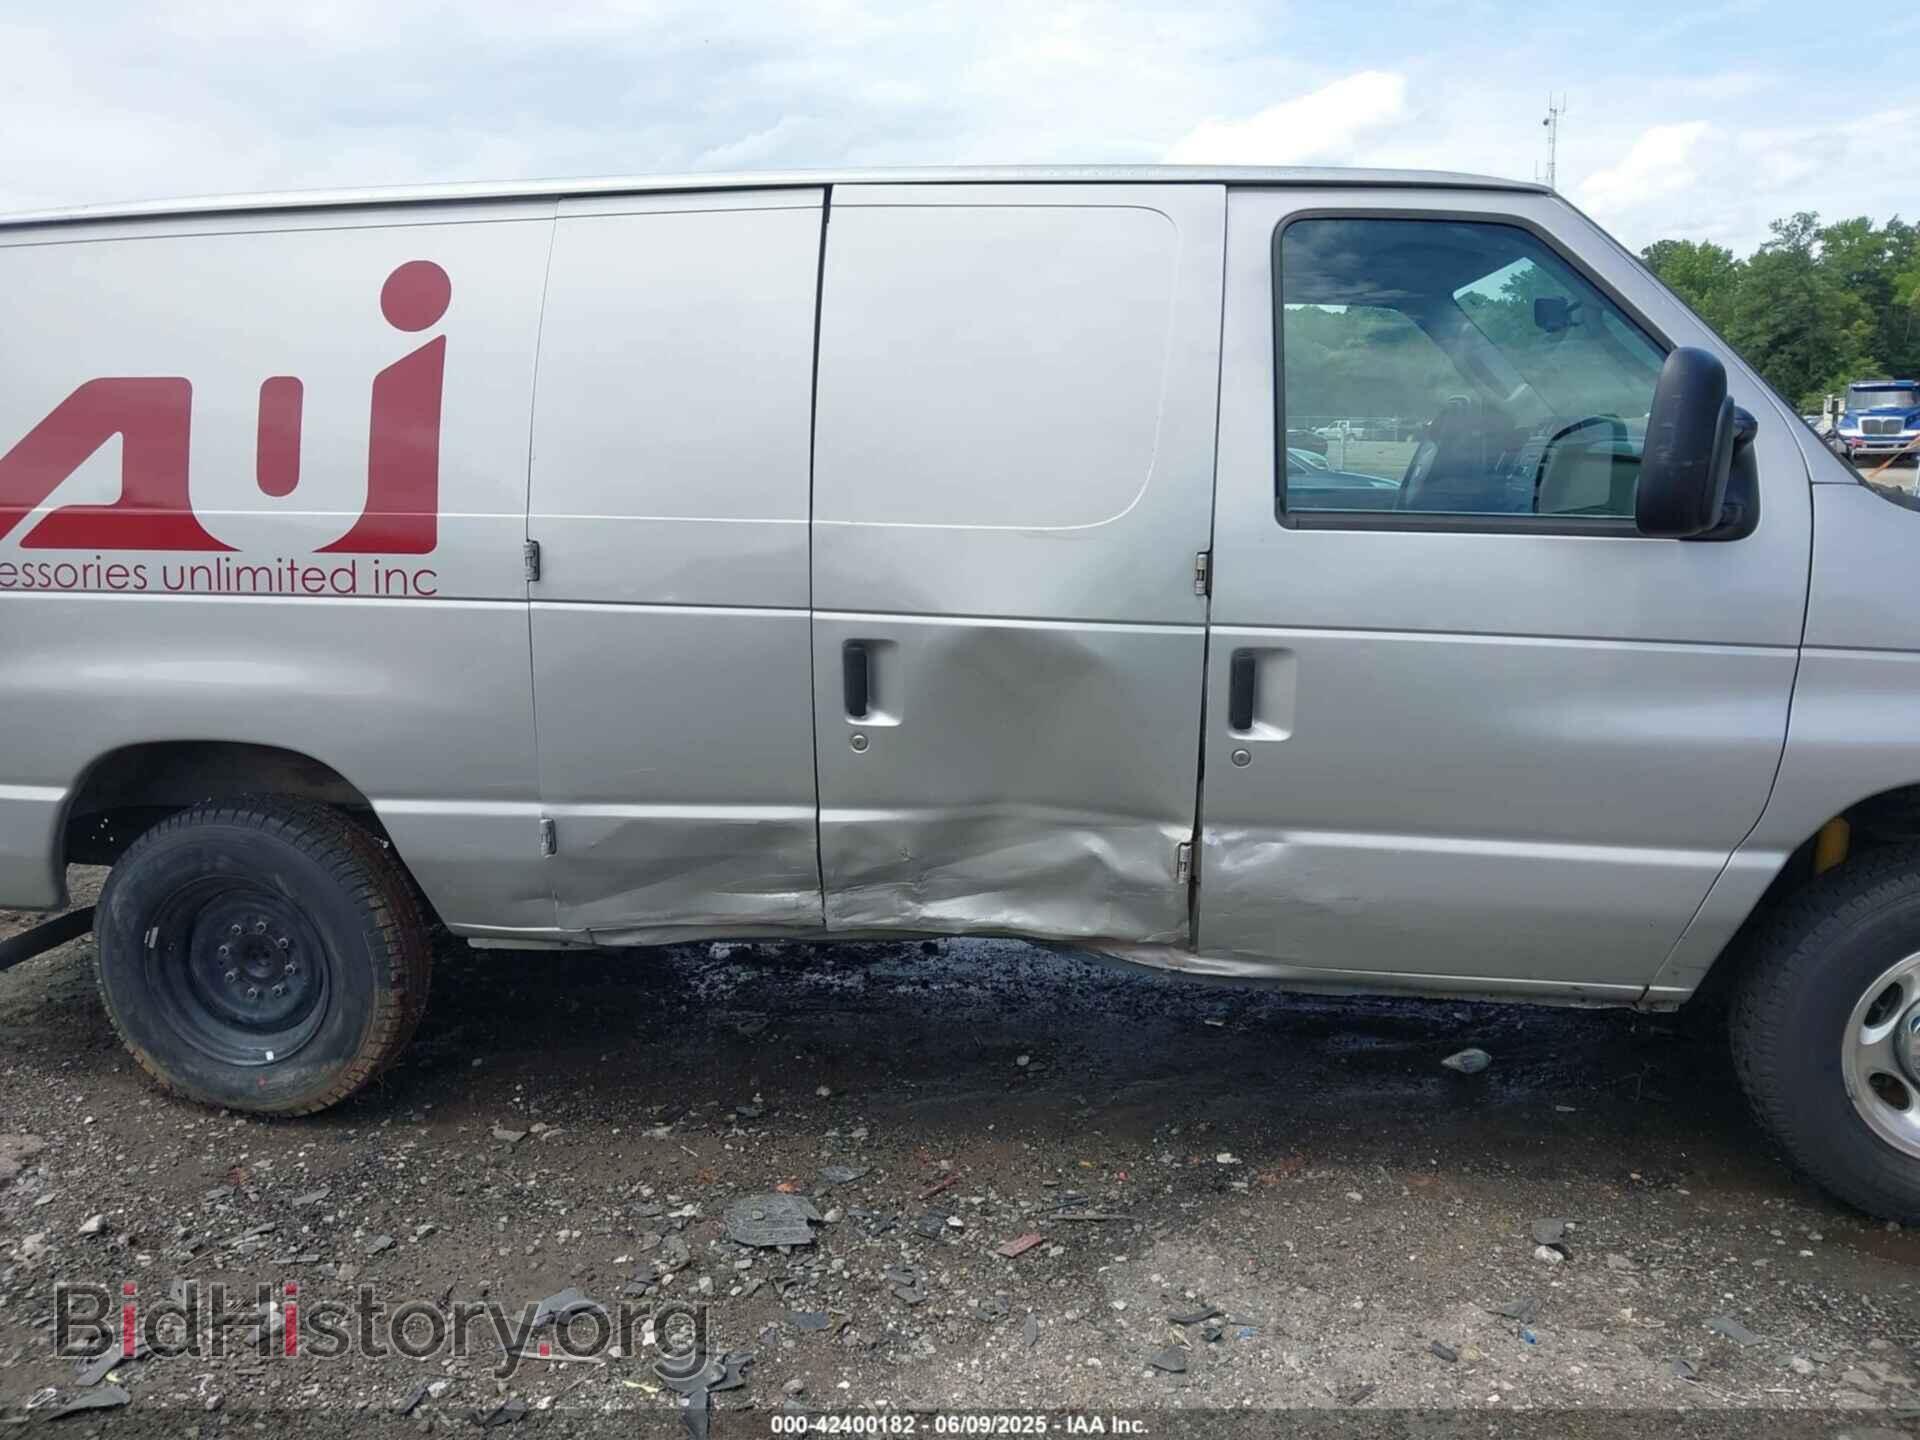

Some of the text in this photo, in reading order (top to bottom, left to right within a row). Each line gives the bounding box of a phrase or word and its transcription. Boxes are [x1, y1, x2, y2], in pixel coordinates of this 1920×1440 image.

[0, 555, 438, 596] essories unlimited inc
